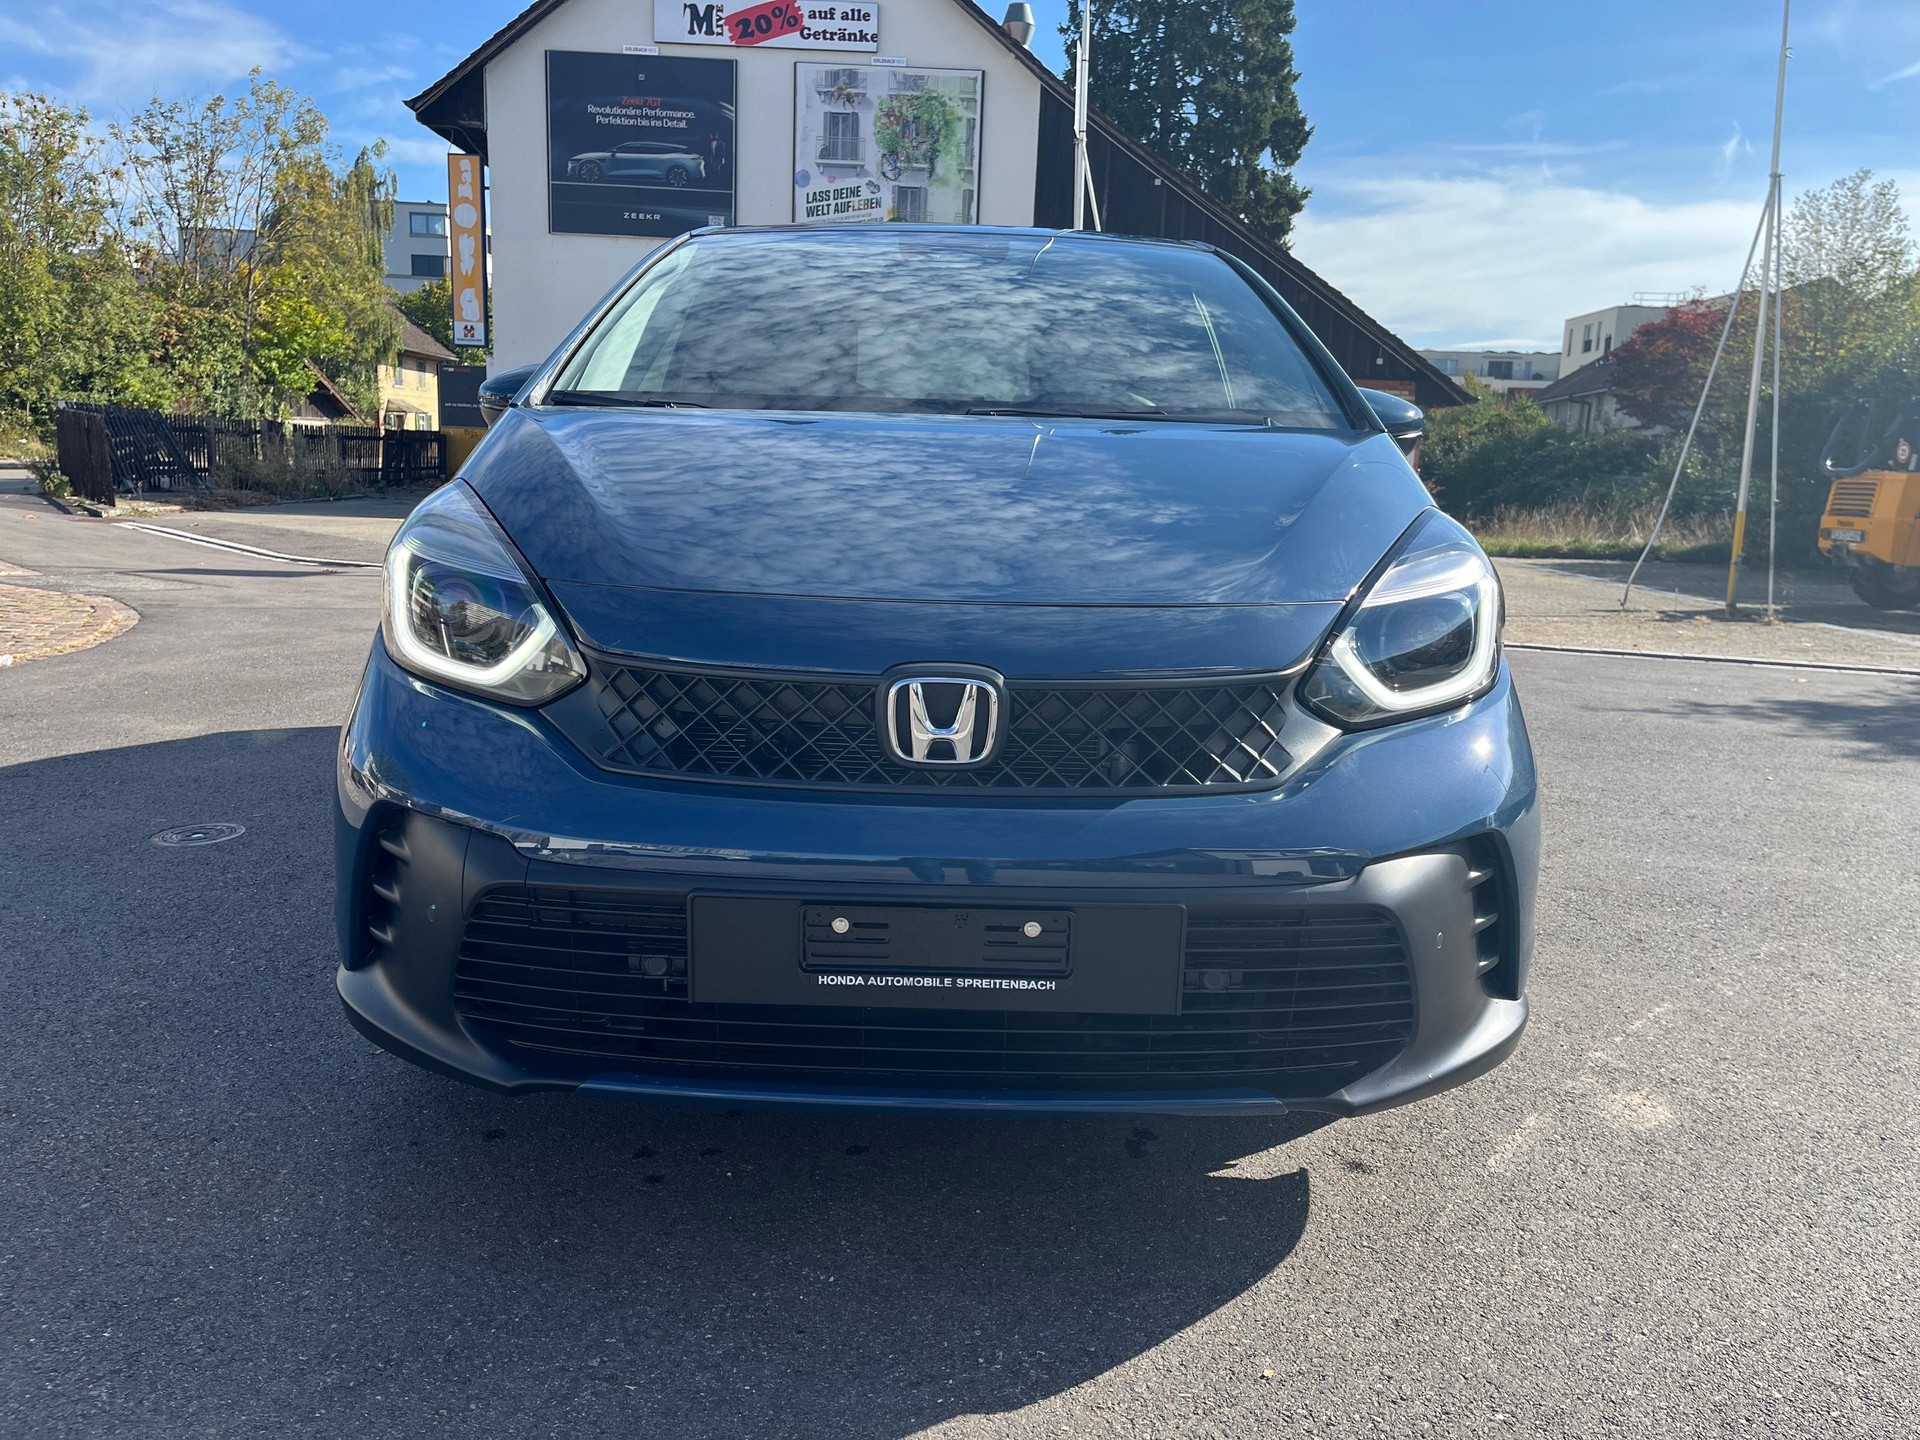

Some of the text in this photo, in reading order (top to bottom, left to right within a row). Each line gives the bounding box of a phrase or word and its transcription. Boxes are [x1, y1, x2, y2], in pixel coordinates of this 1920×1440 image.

[716, 4, 724, 37] LIVE
[735, 4, 798, 39] 20%
[808, 7, 871, 22] auf alle
[800, 27, 878, 43] Getränke
[587, 104, 696, 119] Revolutionäre Performance.
[595, 115, 688, 129] Perfektion bis ins Detail.
[806, 185, 862, 204] LASS DEINE
[805, 196, 882, 218] WELT AUFLEBEN
[623, 212, 661, 221] ZEEKR
[818, 975, 1056, 990] HONDA AUTOMOBILE SPREITENBACH
